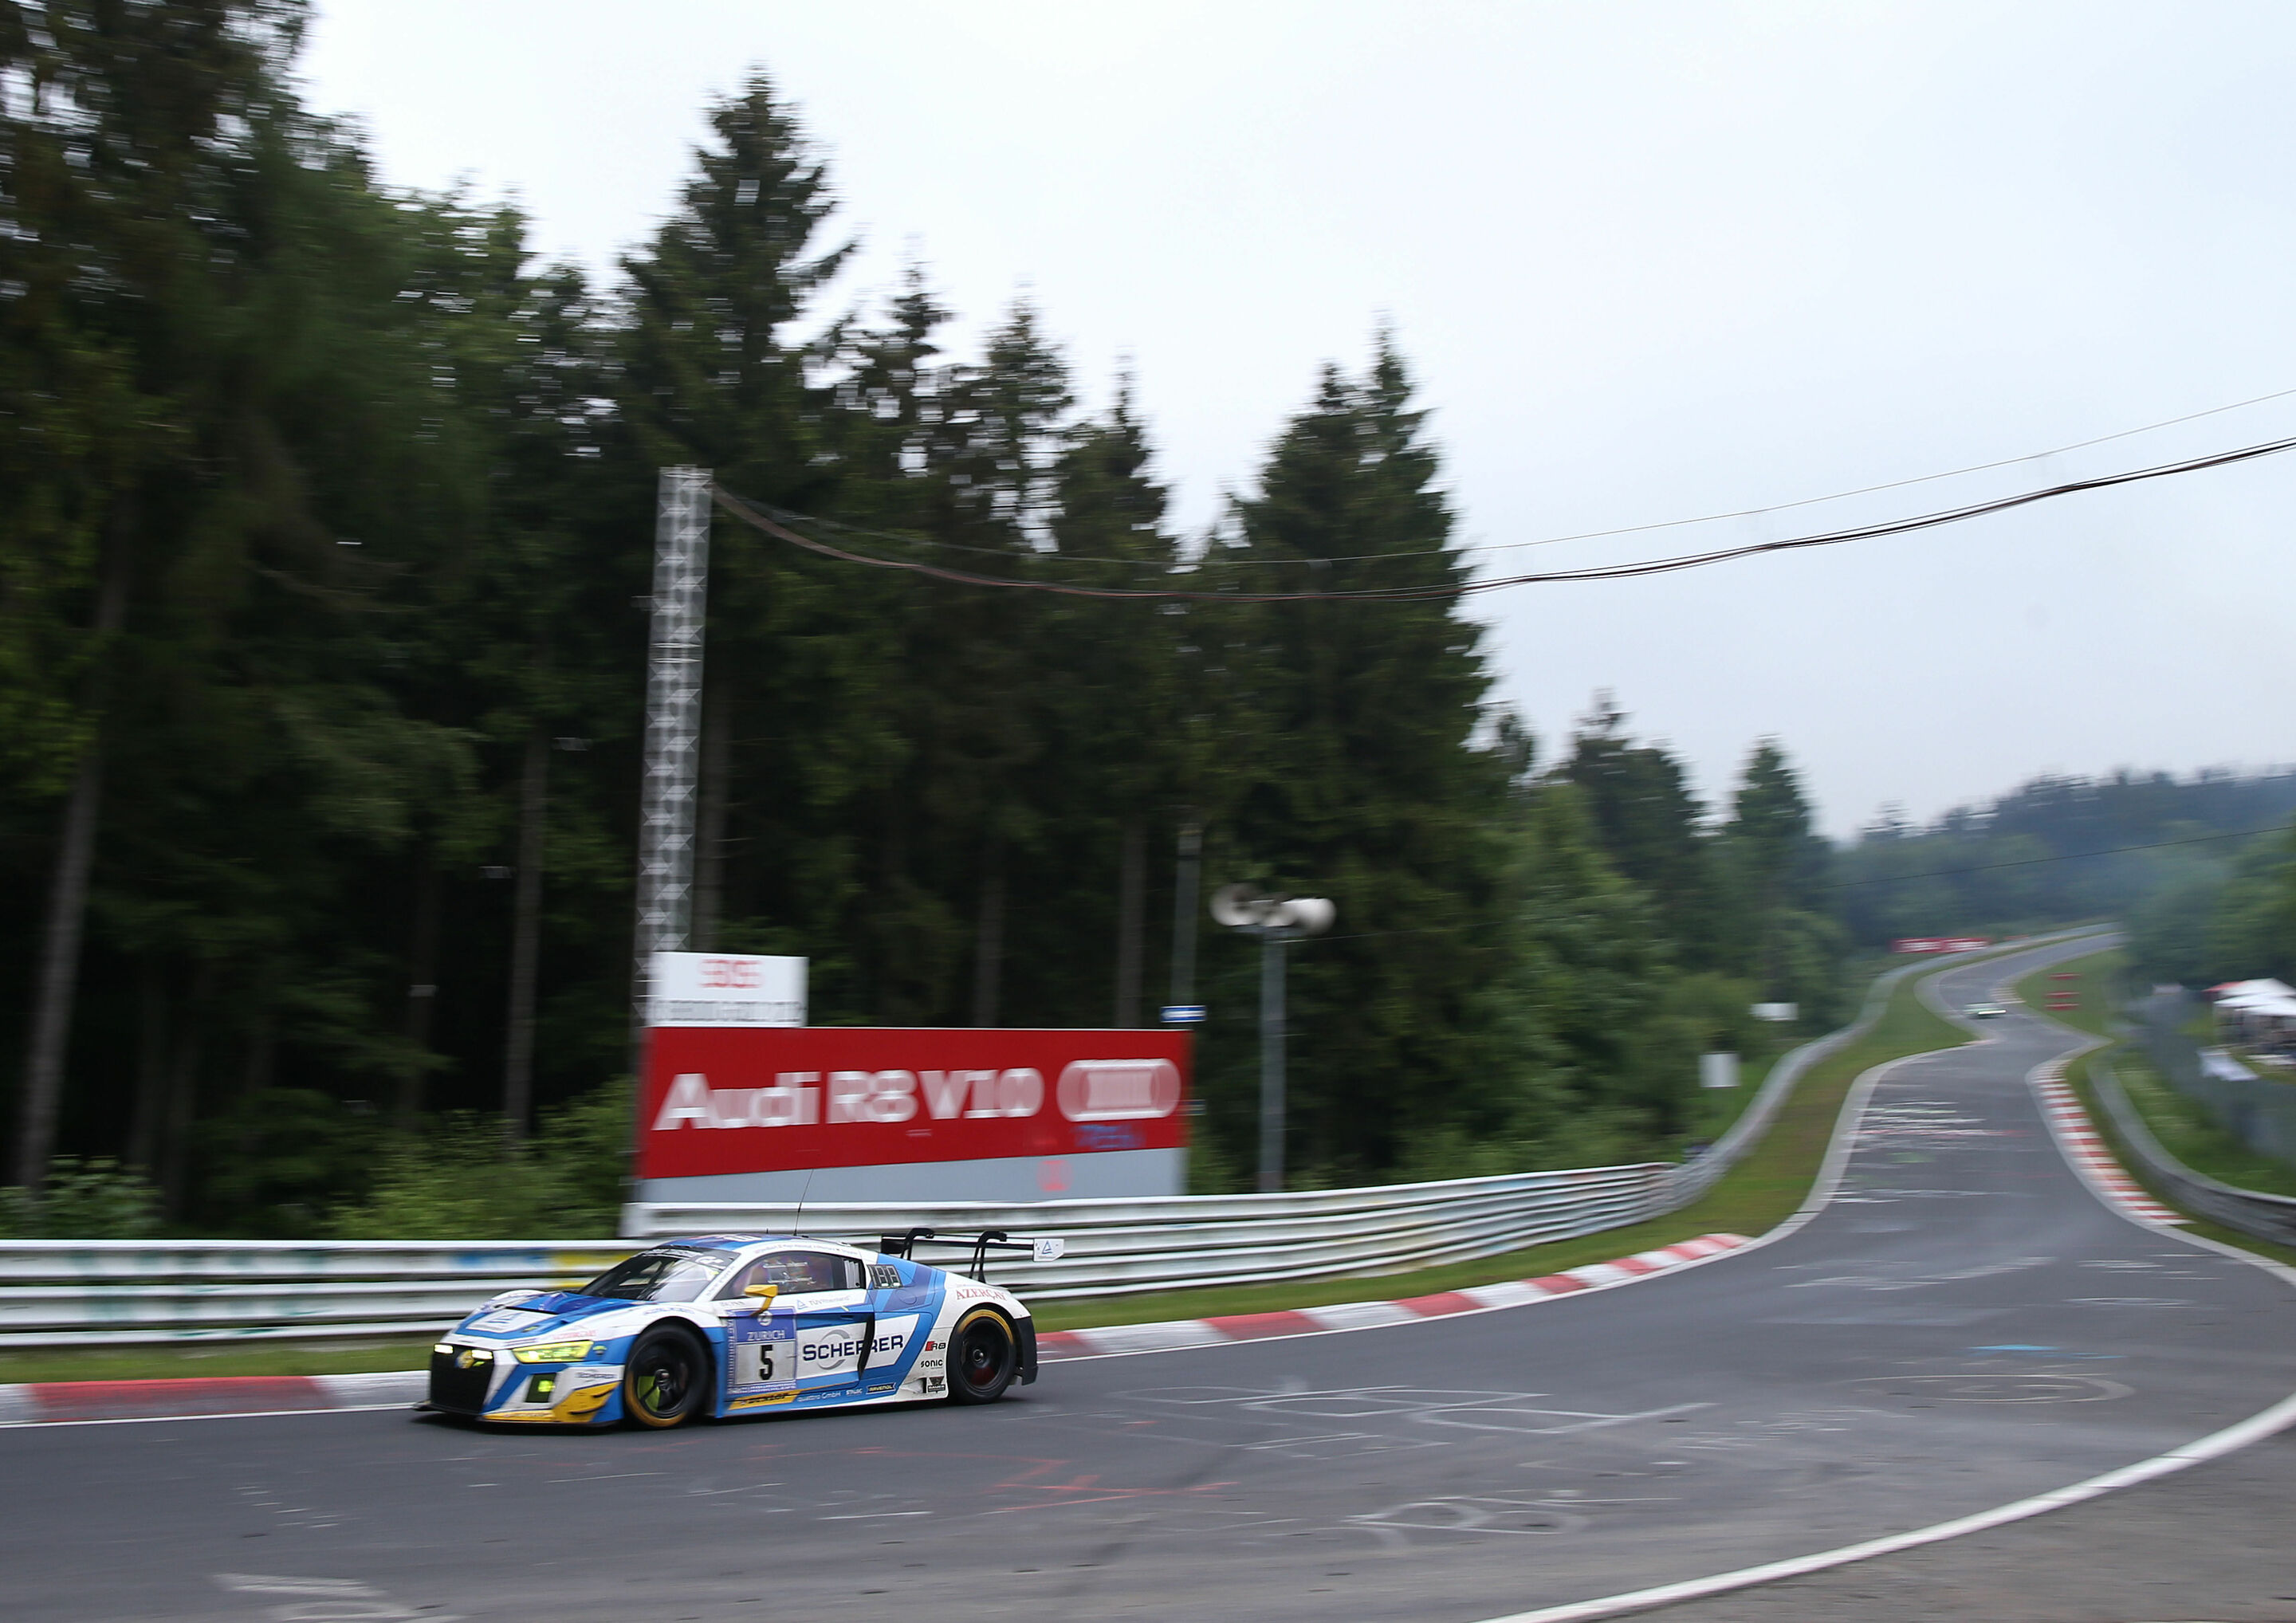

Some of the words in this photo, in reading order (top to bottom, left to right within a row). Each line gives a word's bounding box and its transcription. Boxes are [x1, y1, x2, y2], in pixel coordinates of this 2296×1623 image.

[651, 1071, 821, 1130] Audi
[826, 1069, 918, 1124] R8
[918, 1067, 1044, 1120] V10
[759, 1344, 774, 1381] 5
[931, 1342, 946, 1350] R8
